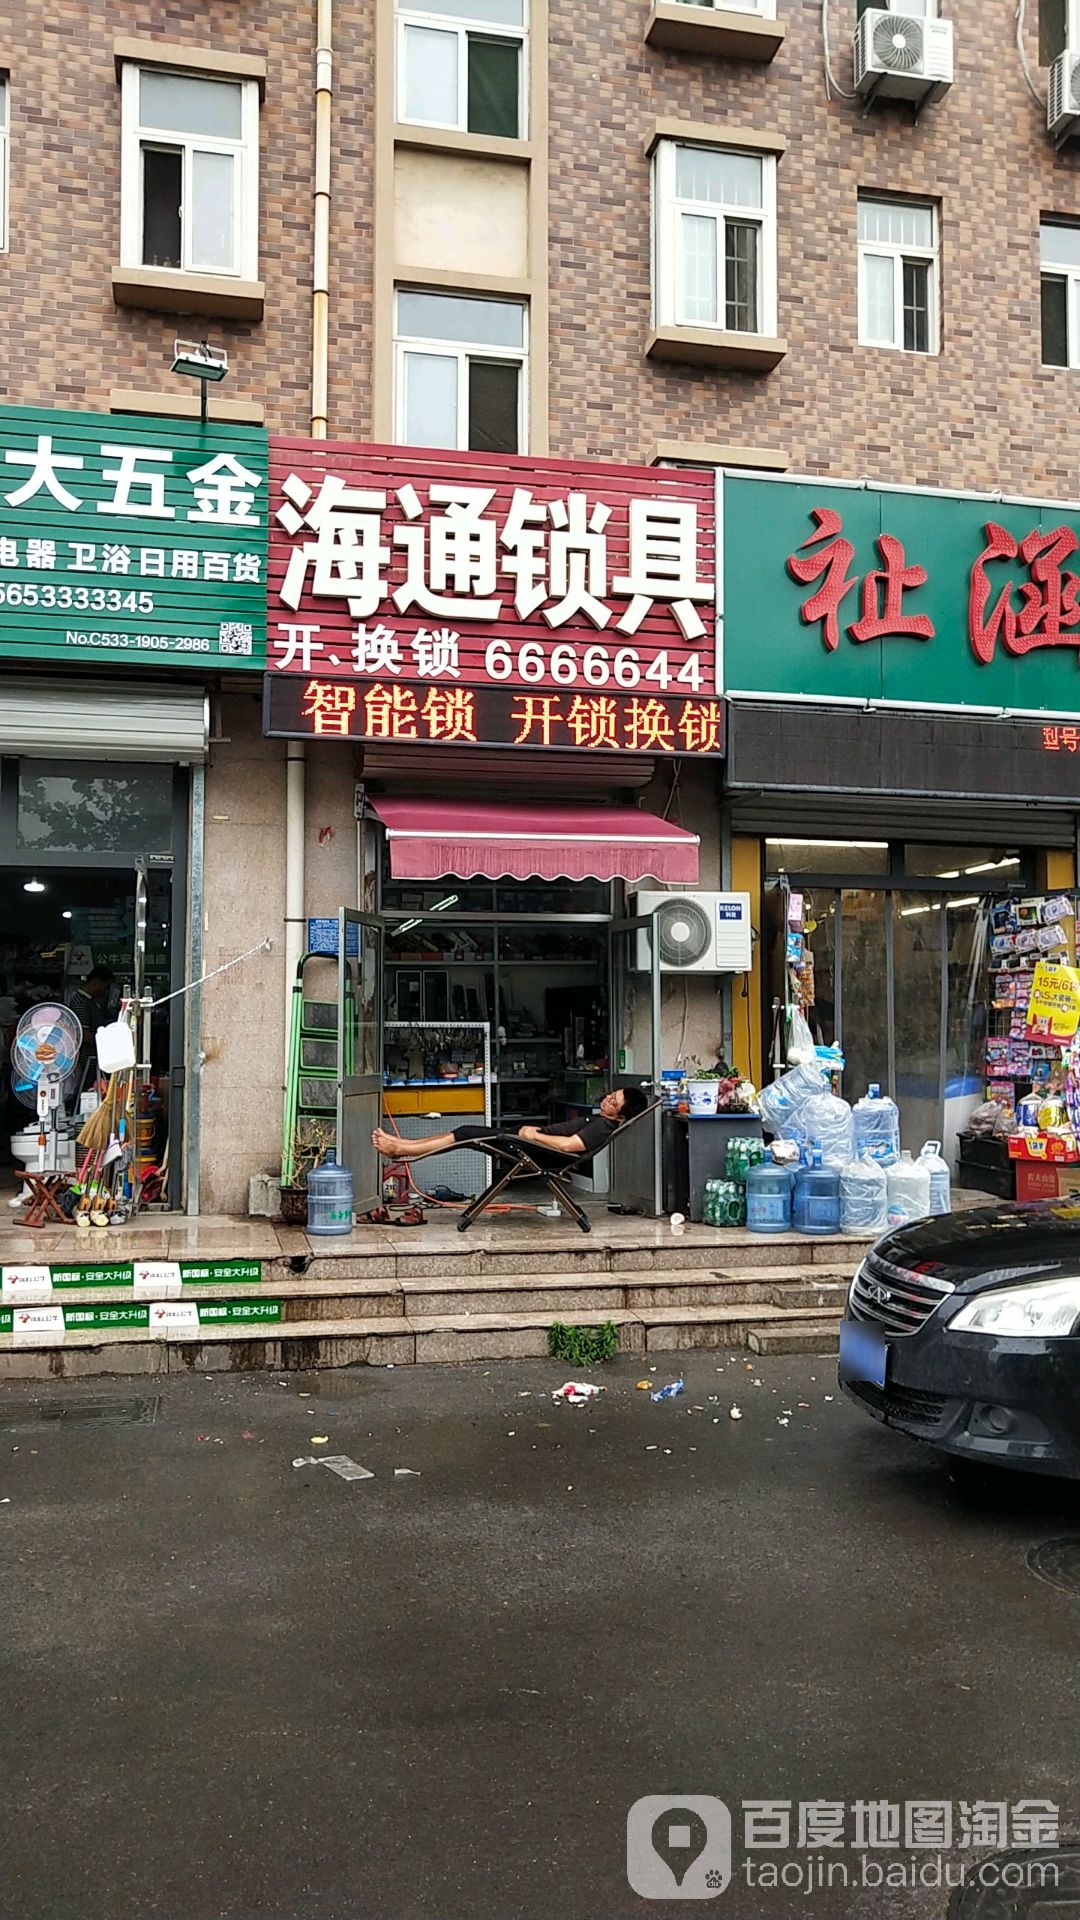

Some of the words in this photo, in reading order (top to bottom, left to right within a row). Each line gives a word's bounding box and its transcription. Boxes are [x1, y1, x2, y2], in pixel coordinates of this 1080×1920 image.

[4, 435, 262, 527] 大五金
[275, 473, 715, 641] 海通锁具
[66, 631, 210, 652] No.C533-1905-2986
[273, 623, 462, 679] 开、换锁
[484, 638, 705, 693] 6666644
[301, 680, 478, 742] 智能锁
[510, 694, 721, 752] 开锁换锁
[1043, 726, 1080, 753] 型号
